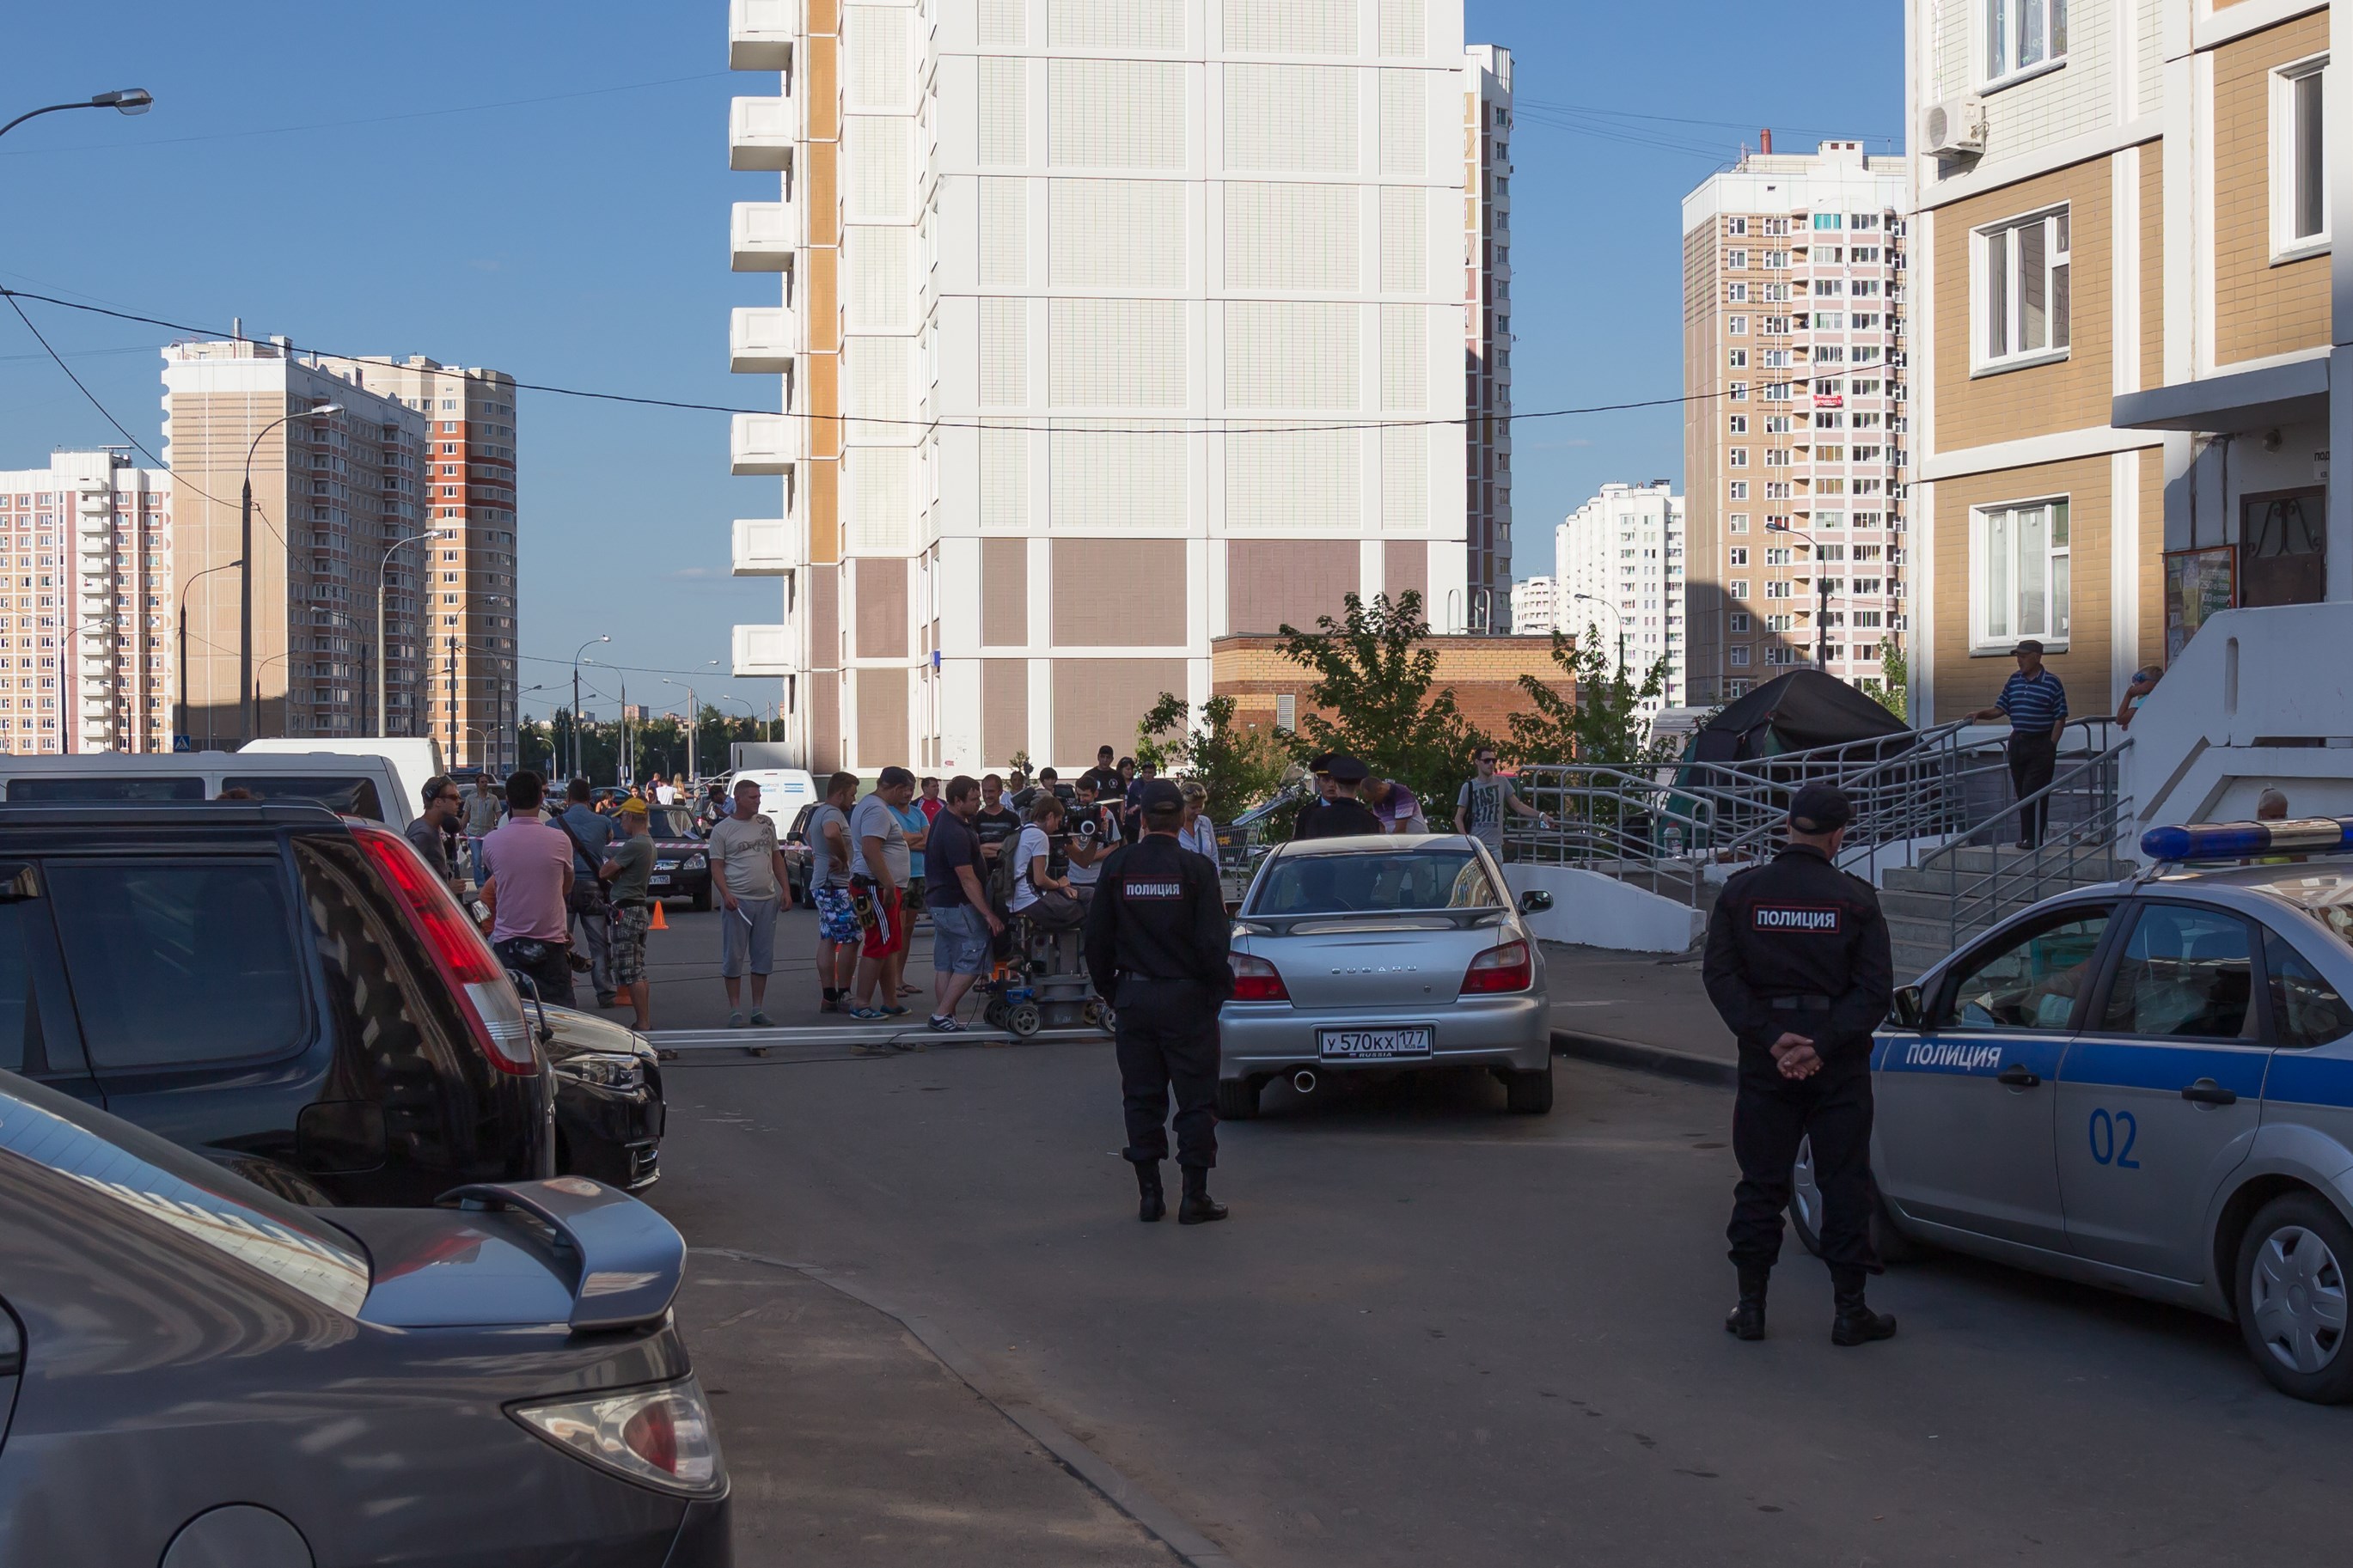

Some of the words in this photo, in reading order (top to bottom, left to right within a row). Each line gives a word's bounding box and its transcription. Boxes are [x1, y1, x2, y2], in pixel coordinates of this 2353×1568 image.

[1126, 883, 1180, 898] ПОЛИЦИЯ
[1757, 910, 1836, 930] ПОЛИЦИЯ
[1331, 965, 1417, 974] SUBARU
[1905, 1044, 2002, 1071] ПОЛИЦИЯ
[2089, 1107, 2140, 1169] 02
